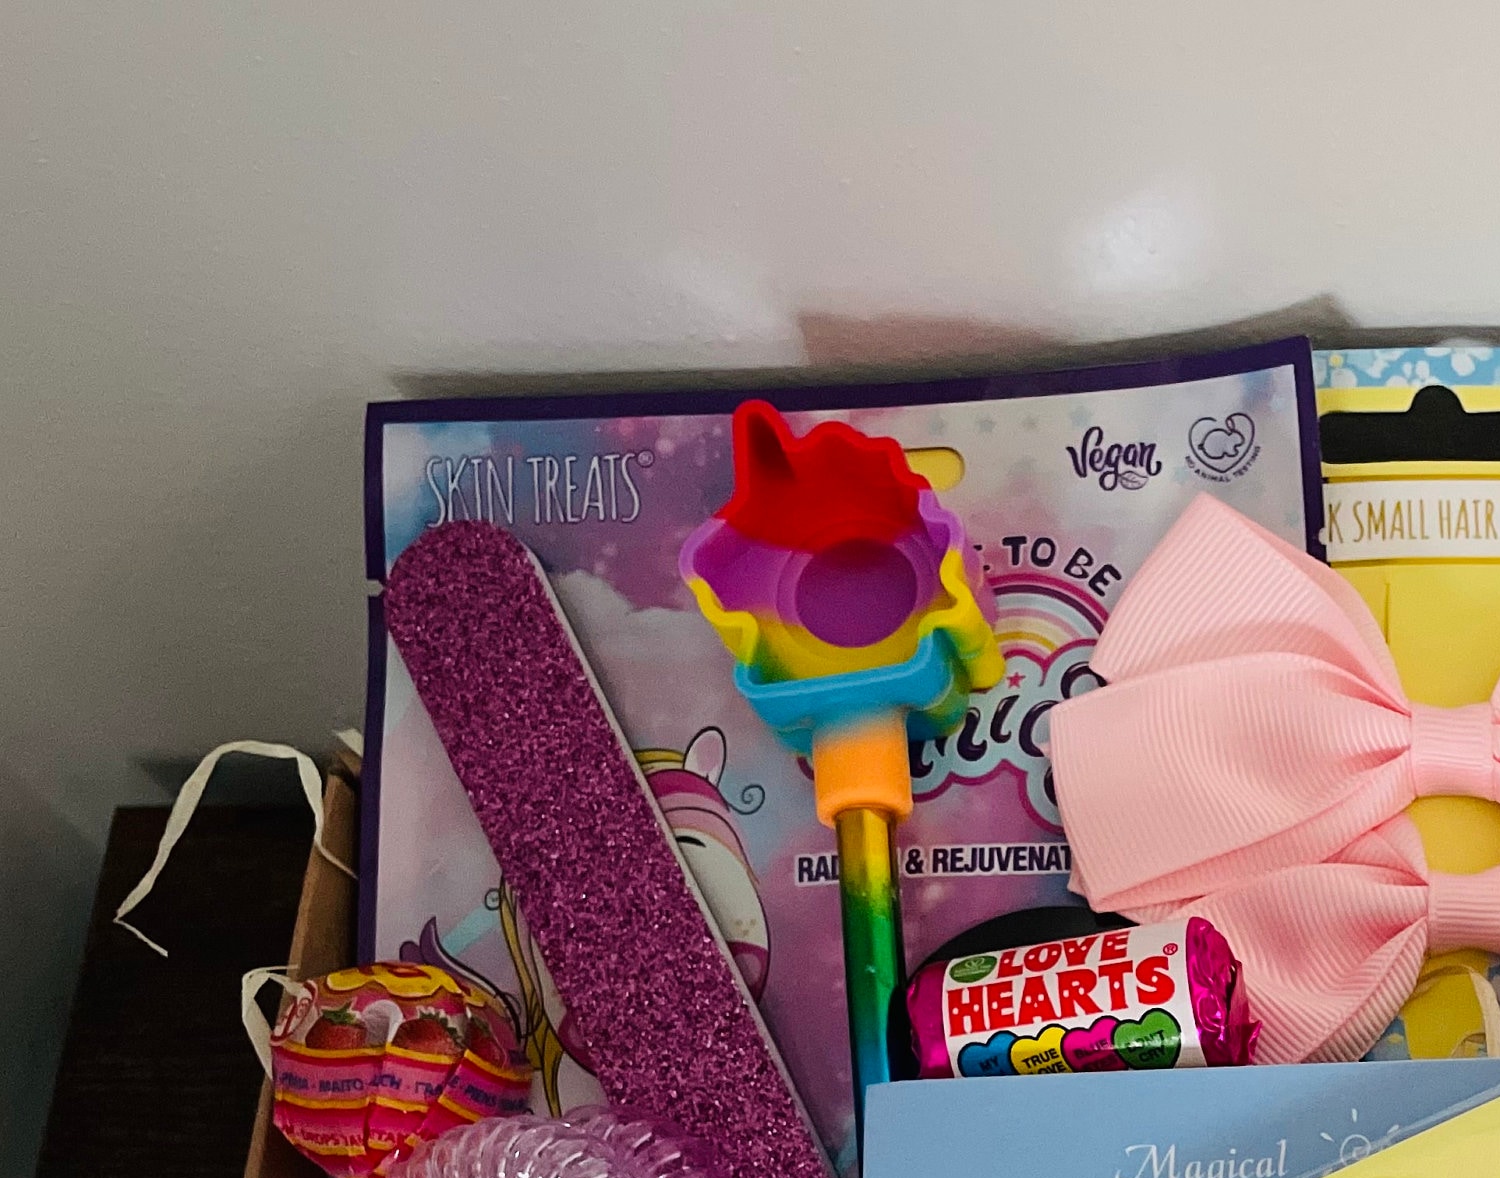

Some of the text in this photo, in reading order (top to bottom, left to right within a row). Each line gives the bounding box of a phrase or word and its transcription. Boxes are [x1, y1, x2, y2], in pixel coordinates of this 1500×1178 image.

[1065, 426, 1162, 491] Vegan
[426, 453, 641, 528] SKIN TREATS
[1328, 503, 1343, 544] K
[1352, 499, 1430, 542] SMALL
[1438, 499, 1498, 541] HAIR
[1002, 535, 1056, 567] TO
[1063, 547, 1122, 597] BE
[905, 848, 923, 874] &
[932, 845, 1073, 873] REJUVENAT
[997, 930, 1132, 980] LOVE
[948, 955, 1176, 1038] HEARTS
[1021, 1047, 1060, 1070] TRUE
[1138, 1044, 1167, 1064] CRY
